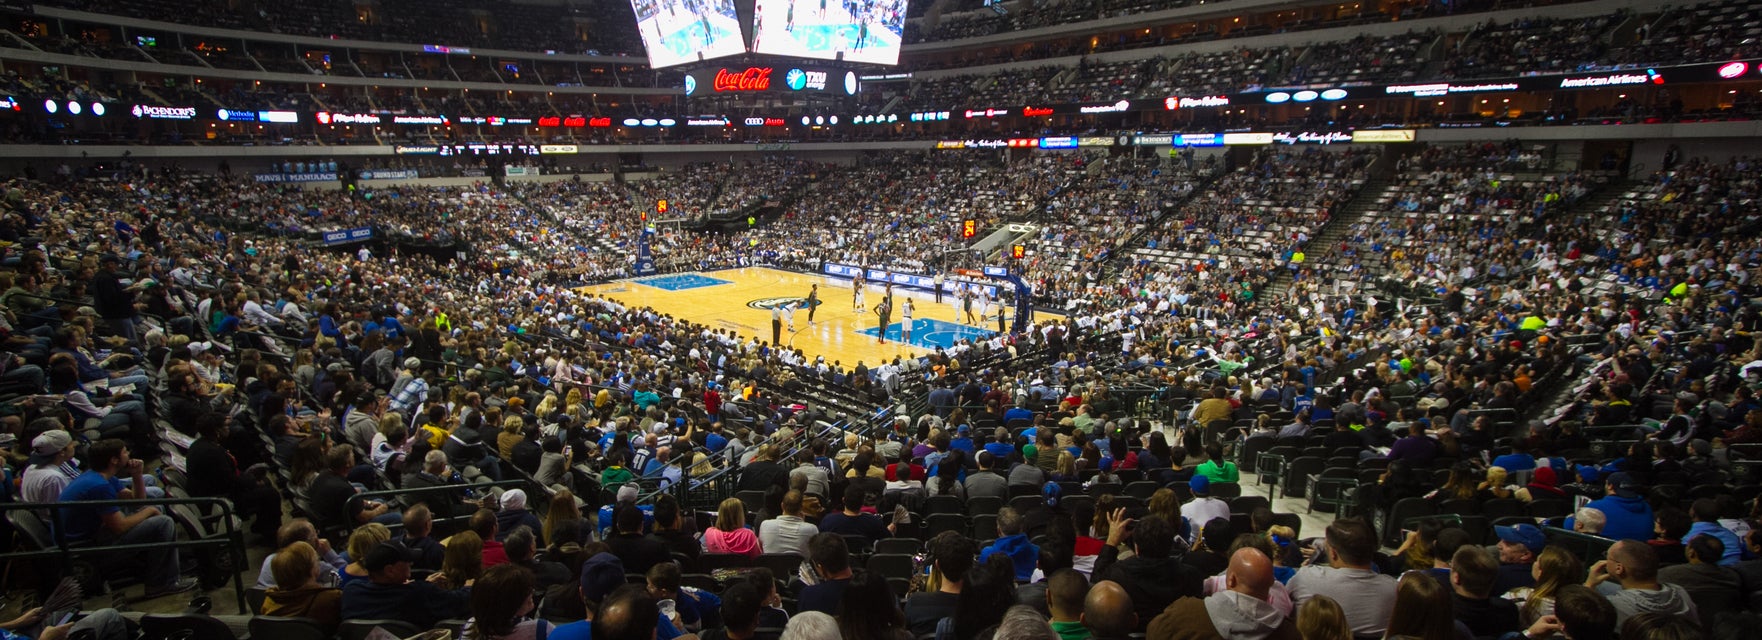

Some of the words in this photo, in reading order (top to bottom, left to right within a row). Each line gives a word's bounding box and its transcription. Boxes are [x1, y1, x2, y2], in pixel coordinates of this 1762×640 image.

[714, 67, 773, 92] Coca-Cola
[806, 71, 826, 83] TXU
[1560, 76, 1607, 88] American
[1607, 74, 1648, 86] Airlines
[806, 82, 825, 90] energy
[765, 118, 785, 126] Audi
